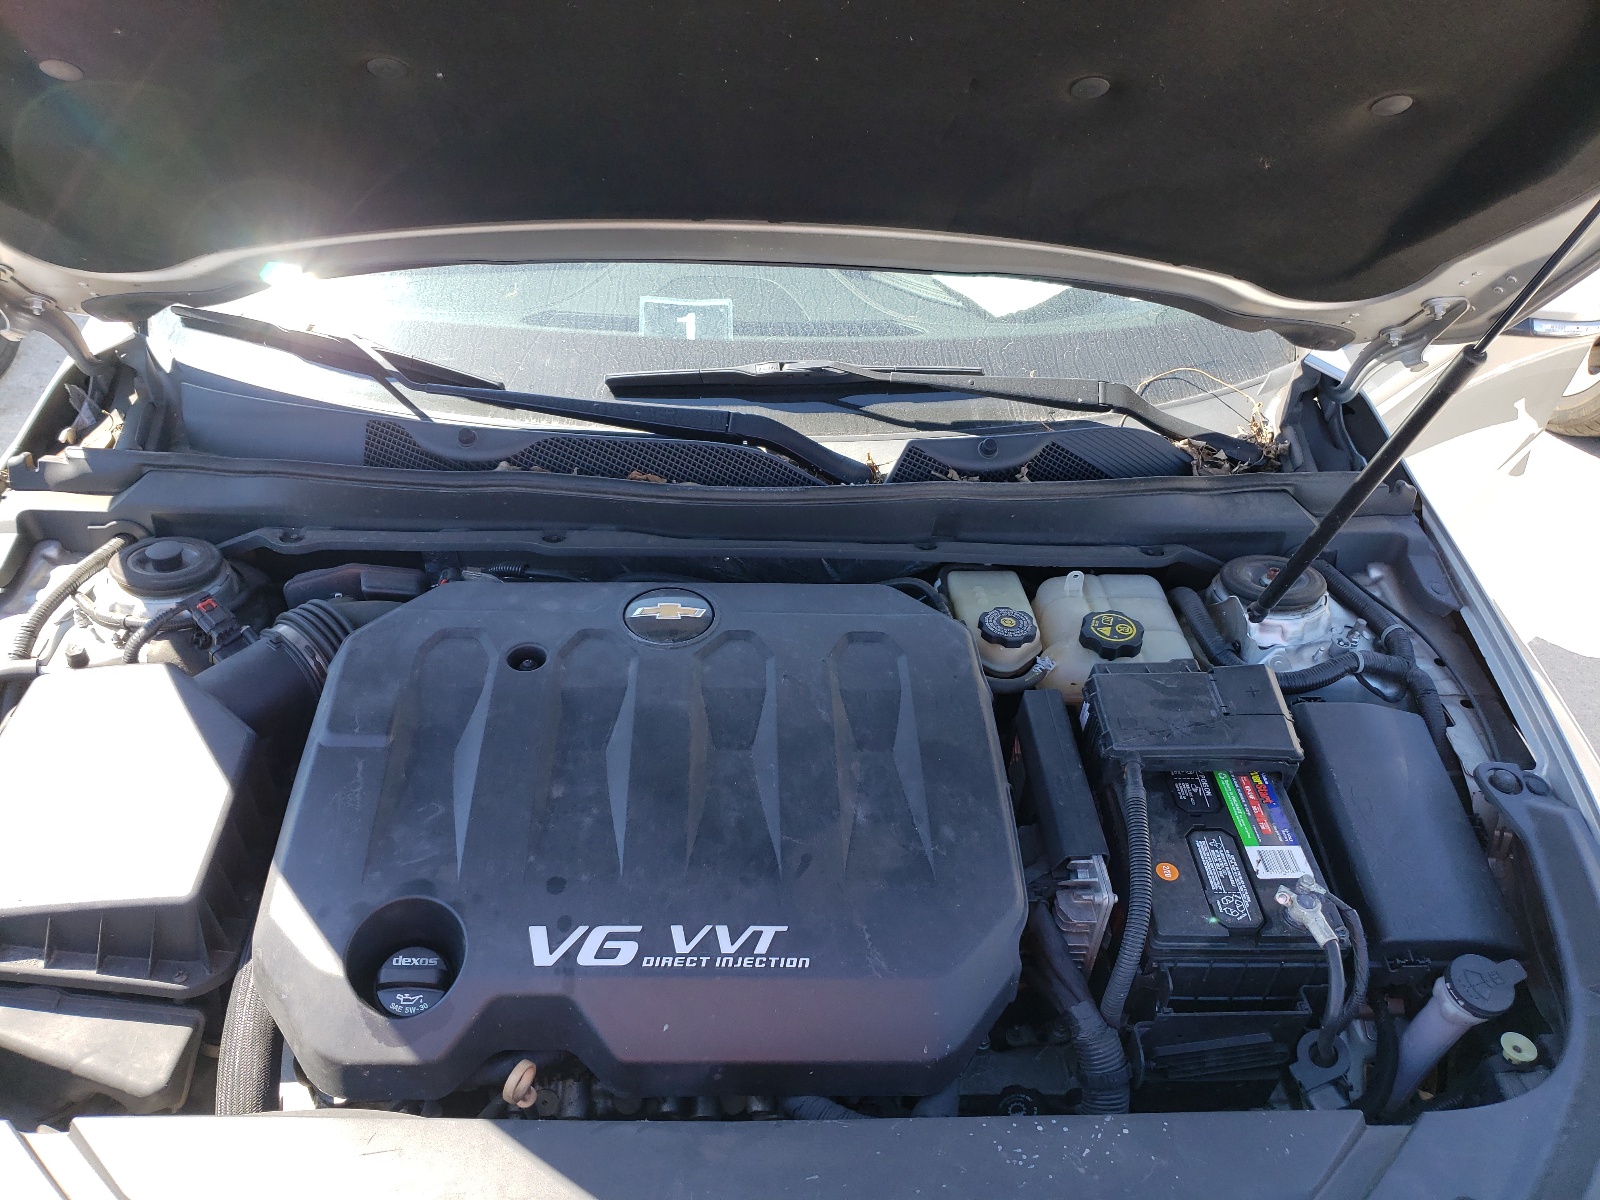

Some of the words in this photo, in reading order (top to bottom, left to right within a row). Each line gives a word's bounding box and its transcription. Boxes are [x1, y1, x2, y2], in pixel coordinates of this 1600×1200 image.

[528, 925, 643, 967] V6
[670, 924, 789, 955] VVT
[392, 955, 440, 966] dexos
[642, 956, 711, 968] DIRECT
[715, 956, 810, 968] INJECTION
[389, 1002, 404, 1013] SAE
[404, 1002, 429, 1014] 5W-30
